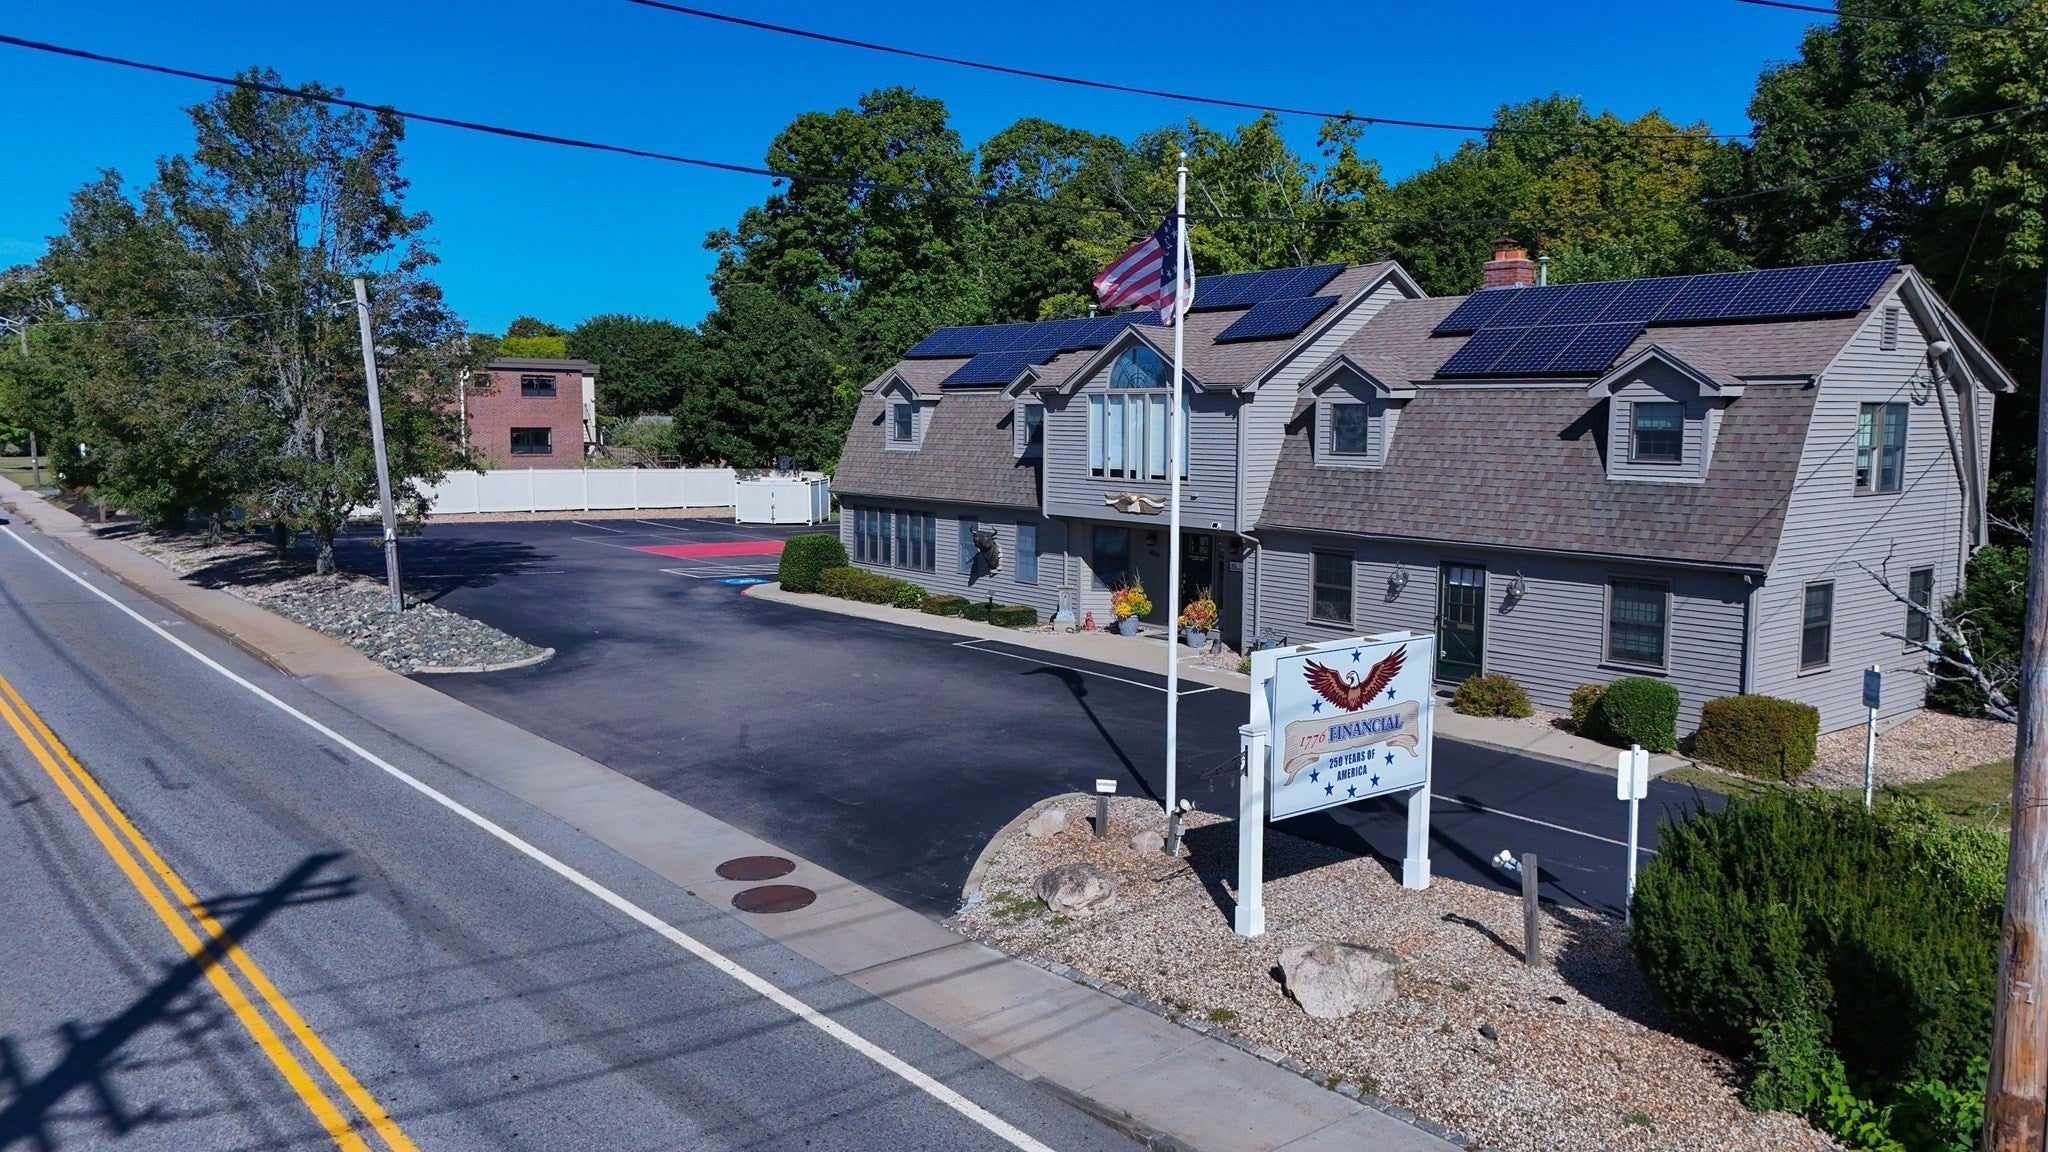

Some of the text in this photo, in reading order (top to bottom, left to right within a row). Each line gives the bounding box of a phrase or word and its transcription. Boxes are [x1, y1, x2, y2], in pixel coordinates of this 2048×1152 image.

[1300, 713, 1404, 750] 1776 FINANCIAL
[1329, 749, 1376, 769] 250 YEARS OF
[1337, 765, 1367, 781] AMERICA
